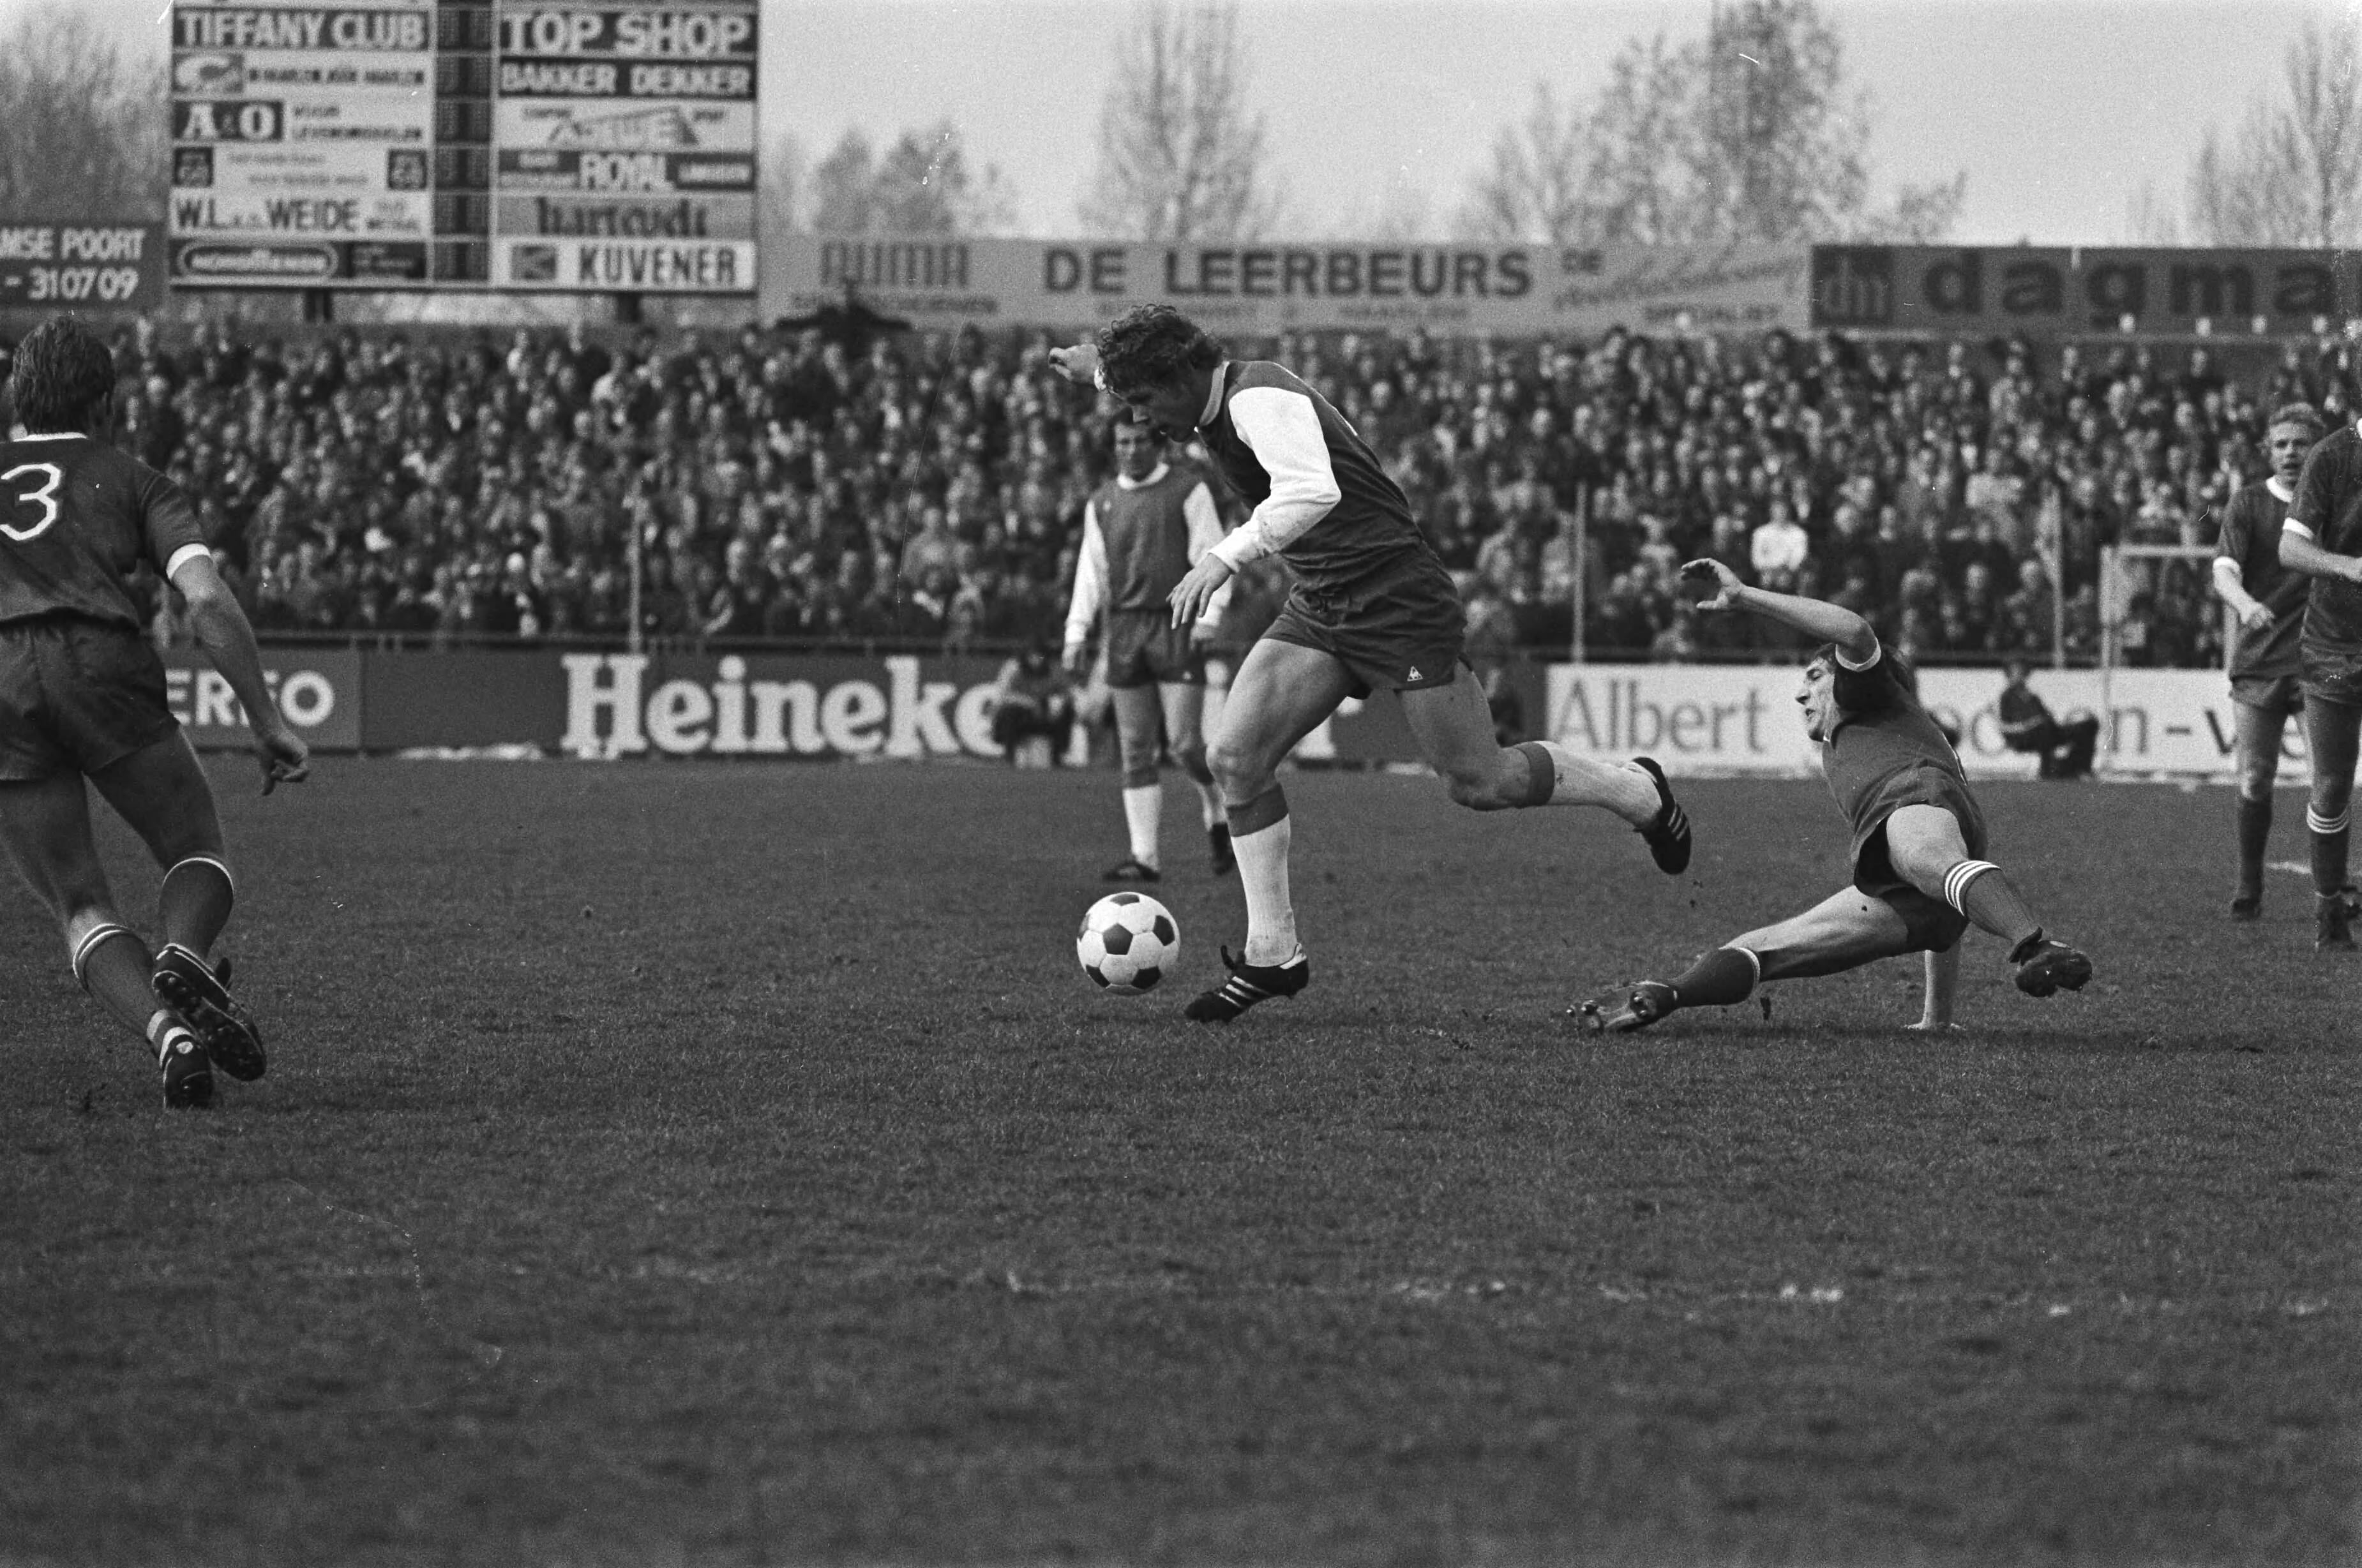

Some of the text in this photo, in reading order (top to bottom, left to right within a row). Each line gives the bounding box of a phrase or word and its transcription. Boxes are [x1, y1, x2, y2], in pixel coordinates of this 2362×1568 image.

[177, 11, 426, 47] TIFFANY CLUB
[503, 13, 751, 56] TOP SHOP
[501, 64, 751, 94] BAKKER DEKKER
[580, 154, 675, 190] ROYAL
[266, 199, 359, 231] WEIDE
[62, 227, 146, 262] POORT
[579, 246, 736, 284] KUVENER
[1045, 248, 1530, 297] DE LEERBEURS
[1923, 251, 2337, 330] dagma
[0, 463, 62, 541] 3
[560, 653, 1089, 762] Heineke
[1554, 678, 1768, 754] Albert
